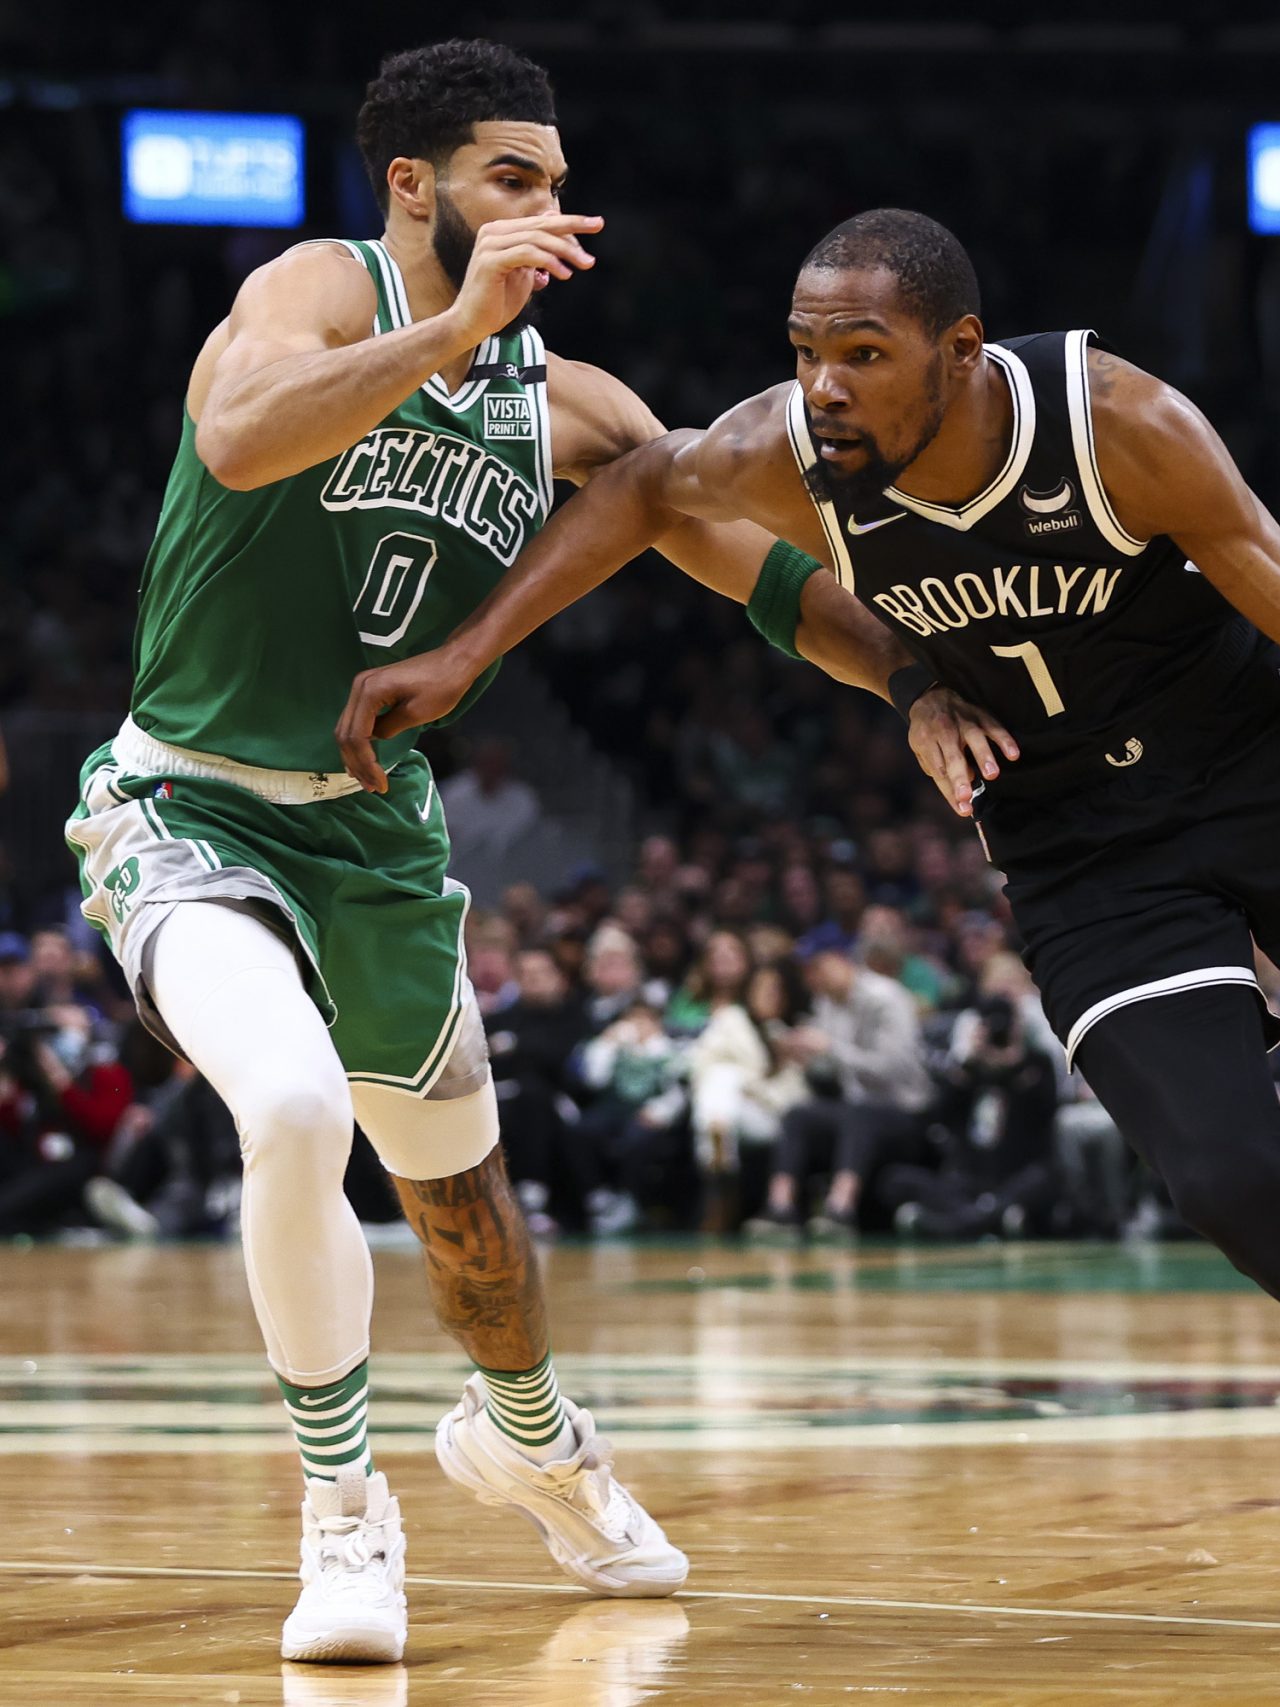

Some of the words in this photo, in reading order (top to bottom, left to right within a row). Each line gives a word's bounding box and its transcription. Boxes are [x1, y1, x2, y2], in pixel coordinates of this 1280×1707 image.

[488, 399, 530, 419] VISTA
[488, 423, 516, 435] PRINT
[320, 428, 538, 567] CELTICS
[1028, 515, 1078, 534] Webull
[352, 531, 438, 647] 0
[872, 565, 1122, 637] BROOKLYN
[990, 640, 1065, 718] 7
